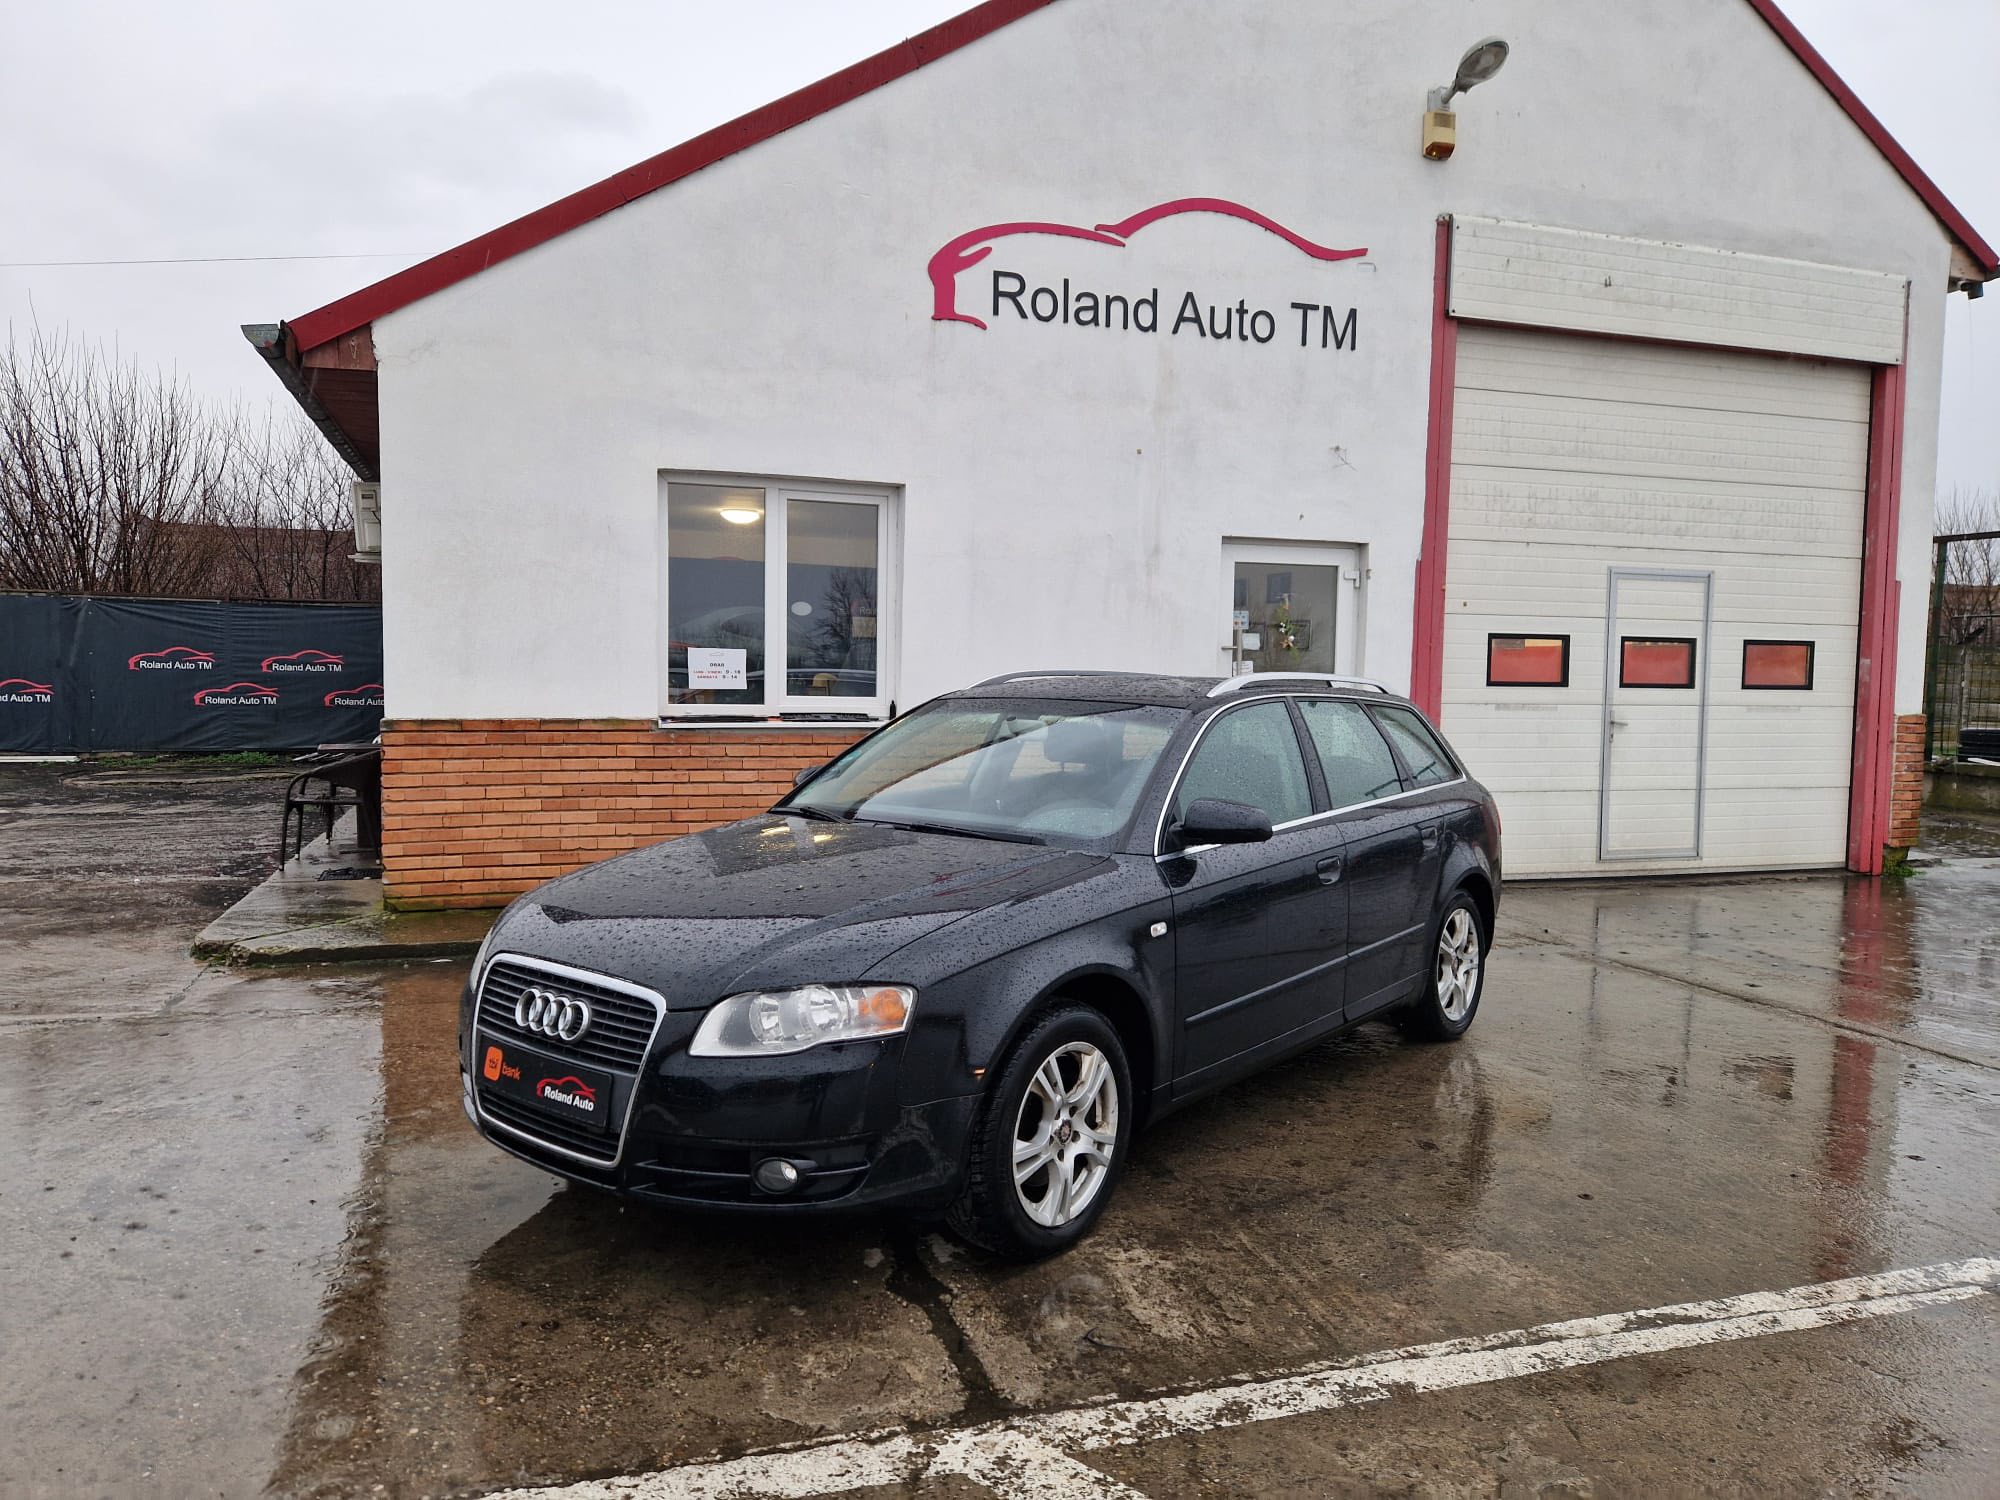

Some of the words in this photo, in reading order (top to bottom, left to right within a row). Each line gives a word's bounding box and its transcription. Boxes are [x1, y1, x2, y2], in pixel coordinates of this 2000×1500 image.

[993, 270, 1158, 333] Roland
[1172, 291, 1276, 344] Auto
[1291, 303, 1357, 351] TM
[140, 660, 172, 669] Roland
[174, 661, 195, 670] Auto
[197, 662, 212, 670] TM
[272, 662, 303, 671] Roland
[305, 663, 326, 671] Auto
[327, 664, 342, 672] TM
[10, 694, 33, 702] Auto
[35, 694, 51, 703] TM
[205, 696, 236, 705] Roland
[238, 696, 260, 705] Auto
[262, 697, 277, 705] TM
[334, 697, 365, 705] Roland
[544, 1085, 573, 1106] Roland
[573, 1096, 594, 1112] Auto
